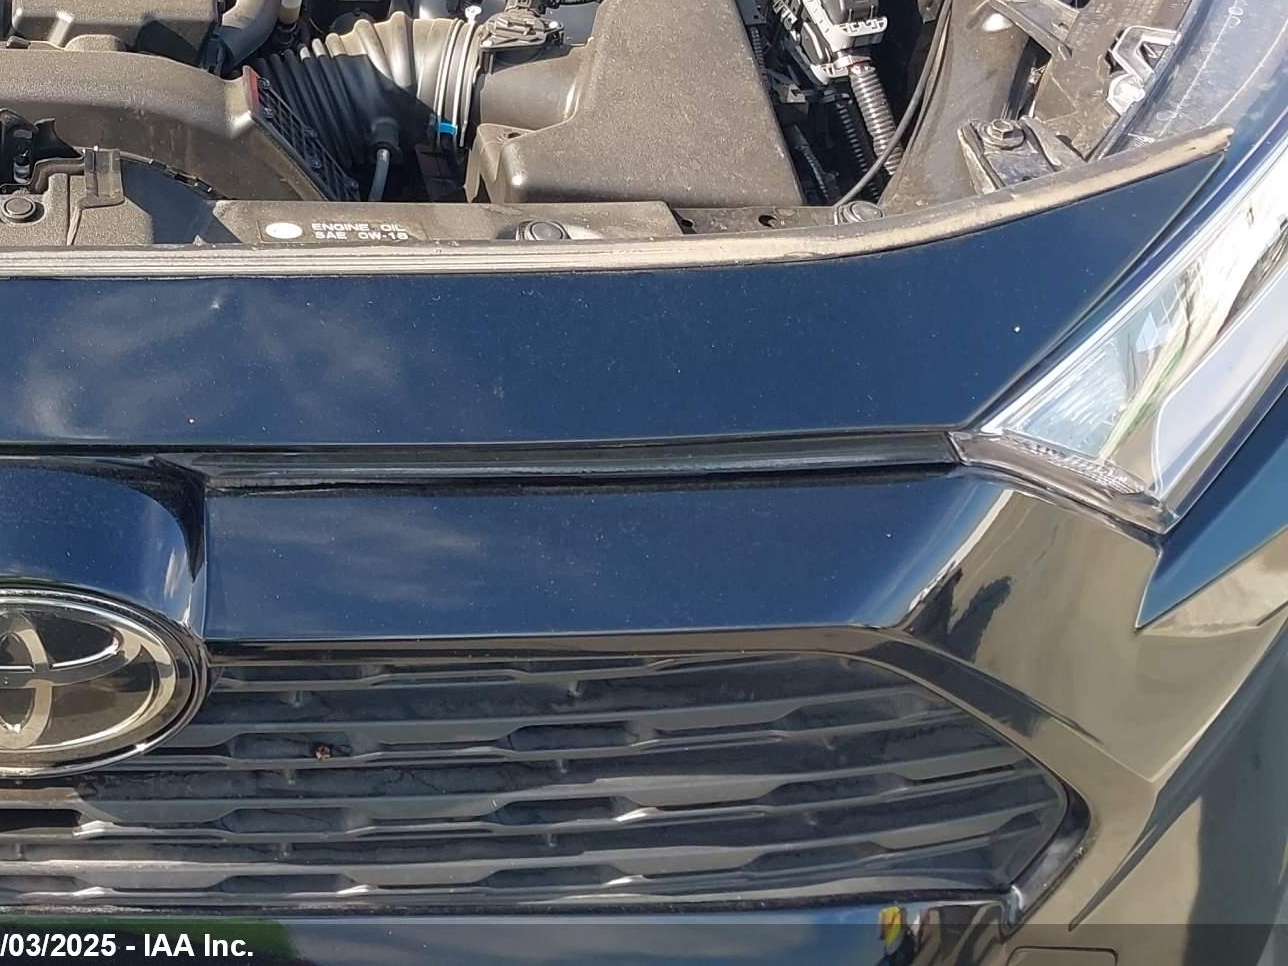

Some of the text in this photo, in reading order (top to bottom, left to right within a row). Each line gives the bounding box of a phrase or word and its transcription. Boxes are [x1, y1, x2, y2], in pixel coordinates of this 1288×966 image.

[312, 222, 407, 232] ENGINE OIL
[315, 231, 348, 240] SAE
